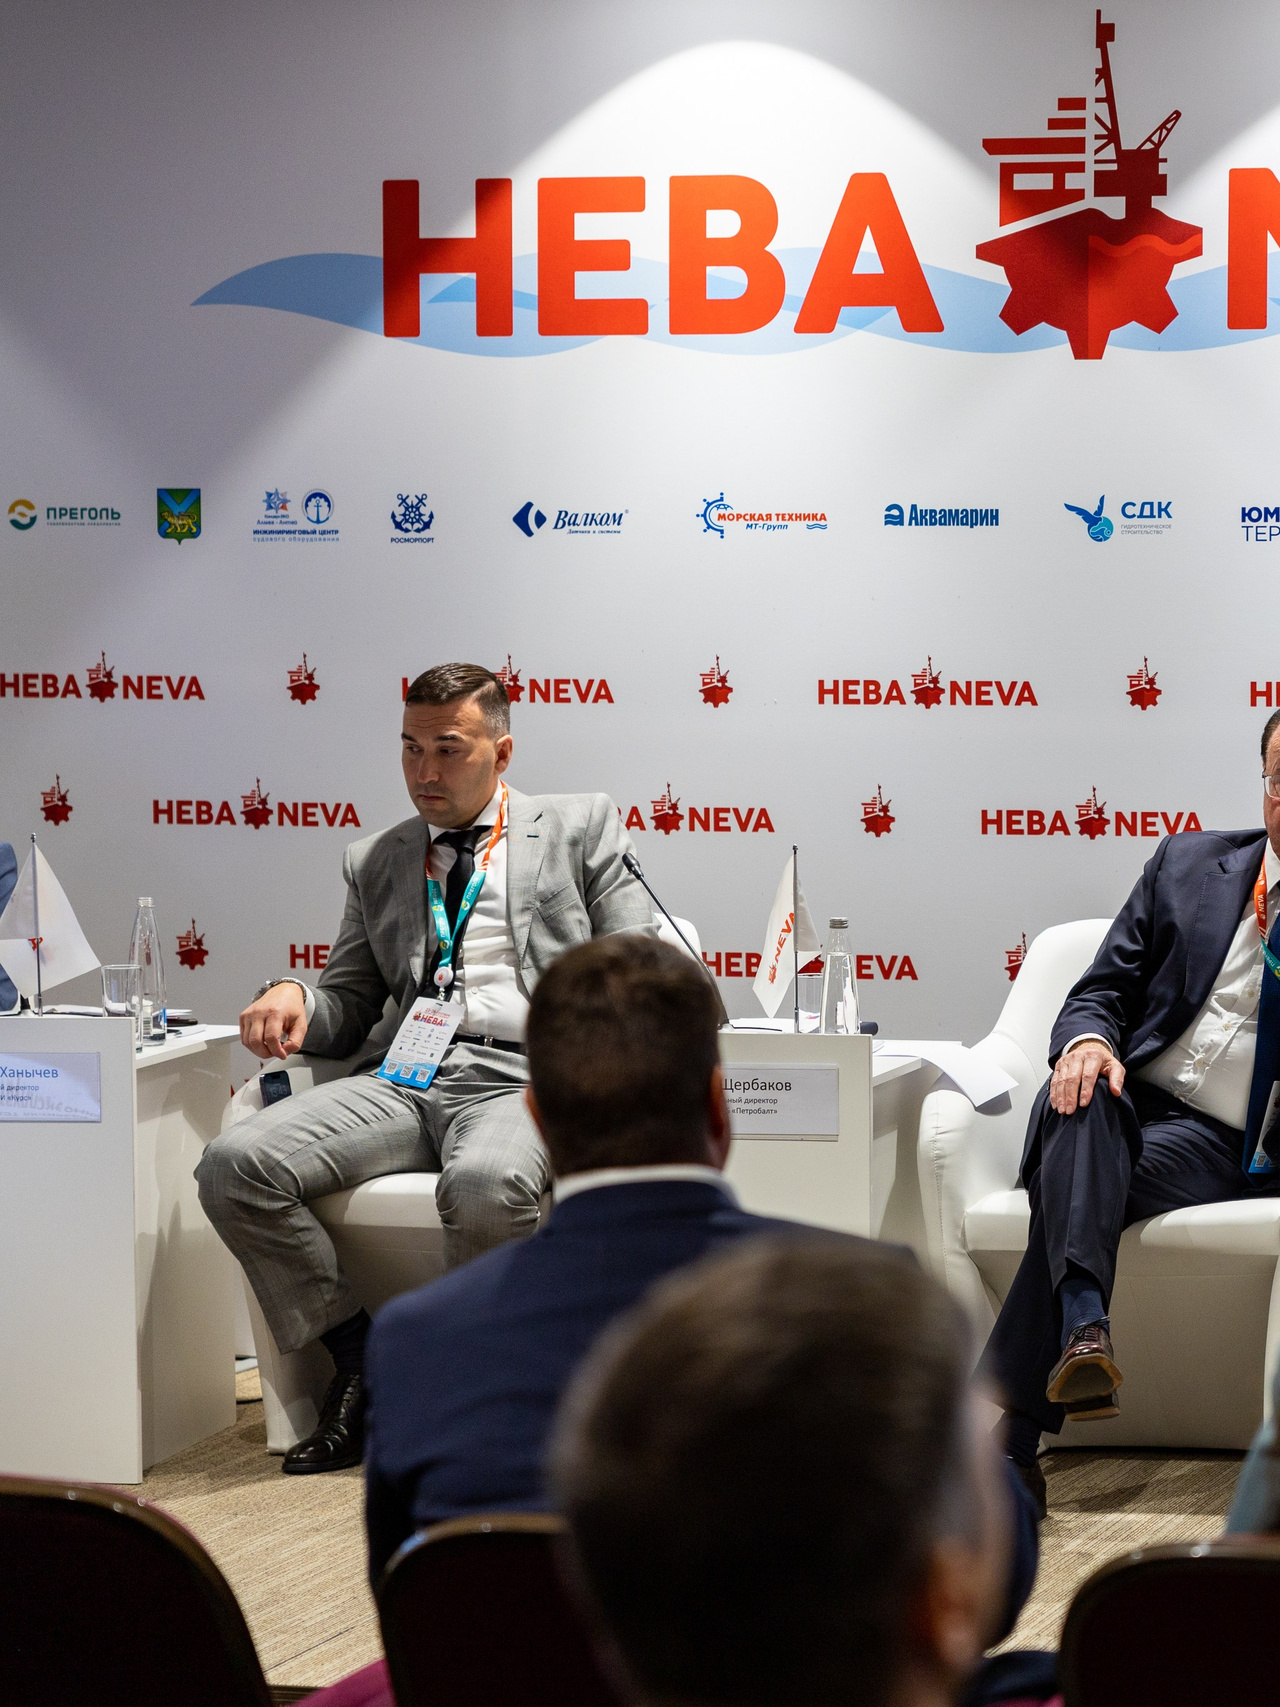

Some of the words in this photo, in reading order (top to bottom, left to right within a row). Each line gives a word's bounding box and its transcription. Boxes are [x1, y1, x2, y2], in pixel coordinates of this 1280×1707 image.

[382, 172, 945, 339] НЕВА
[46, 507, 121, 521] ПРЕГОЛЬ
[717, 512, 773, 522] МОРСКАЯ
[774, 512, 828, 522] ТЕХНИКА
[908, 503, 1000, 529] Аквамарин
[1120, 501, 1173, 519] СДК
[252, 528, 317, 536] ИНЖИНИРИНГОВЫЙ
[745, 523, 789, 532] МТ-Групп
[0, 673, 82, 699] НЕВА
[122, 675, 206, 701] NEVA
[529, 678, 615, 704] NEVA
[817, 679, 907, 706] НЕВА
[949, 680, 1039, 707] NEVA
[152, 799, 237, 826] НЕВА
[277, 801, 361, 828] NEVA
[688, 806, 775, 833] NEVA
[980, 809, 1071, 836] НЕВА
[1114, 811, 1203, 837] NEVA
[289, 944, 331, 970] НЕ
[701, 951, 763, 979] НЕВ
[855, 954, 919, 981] EVA
[0, 1066, 59, 1079] Ханычев
[6, 1084, 40, 1092] директор
[744, 1097, 778, 1105] директор
[731, 1107, 778, 1115] «Петробалт»
